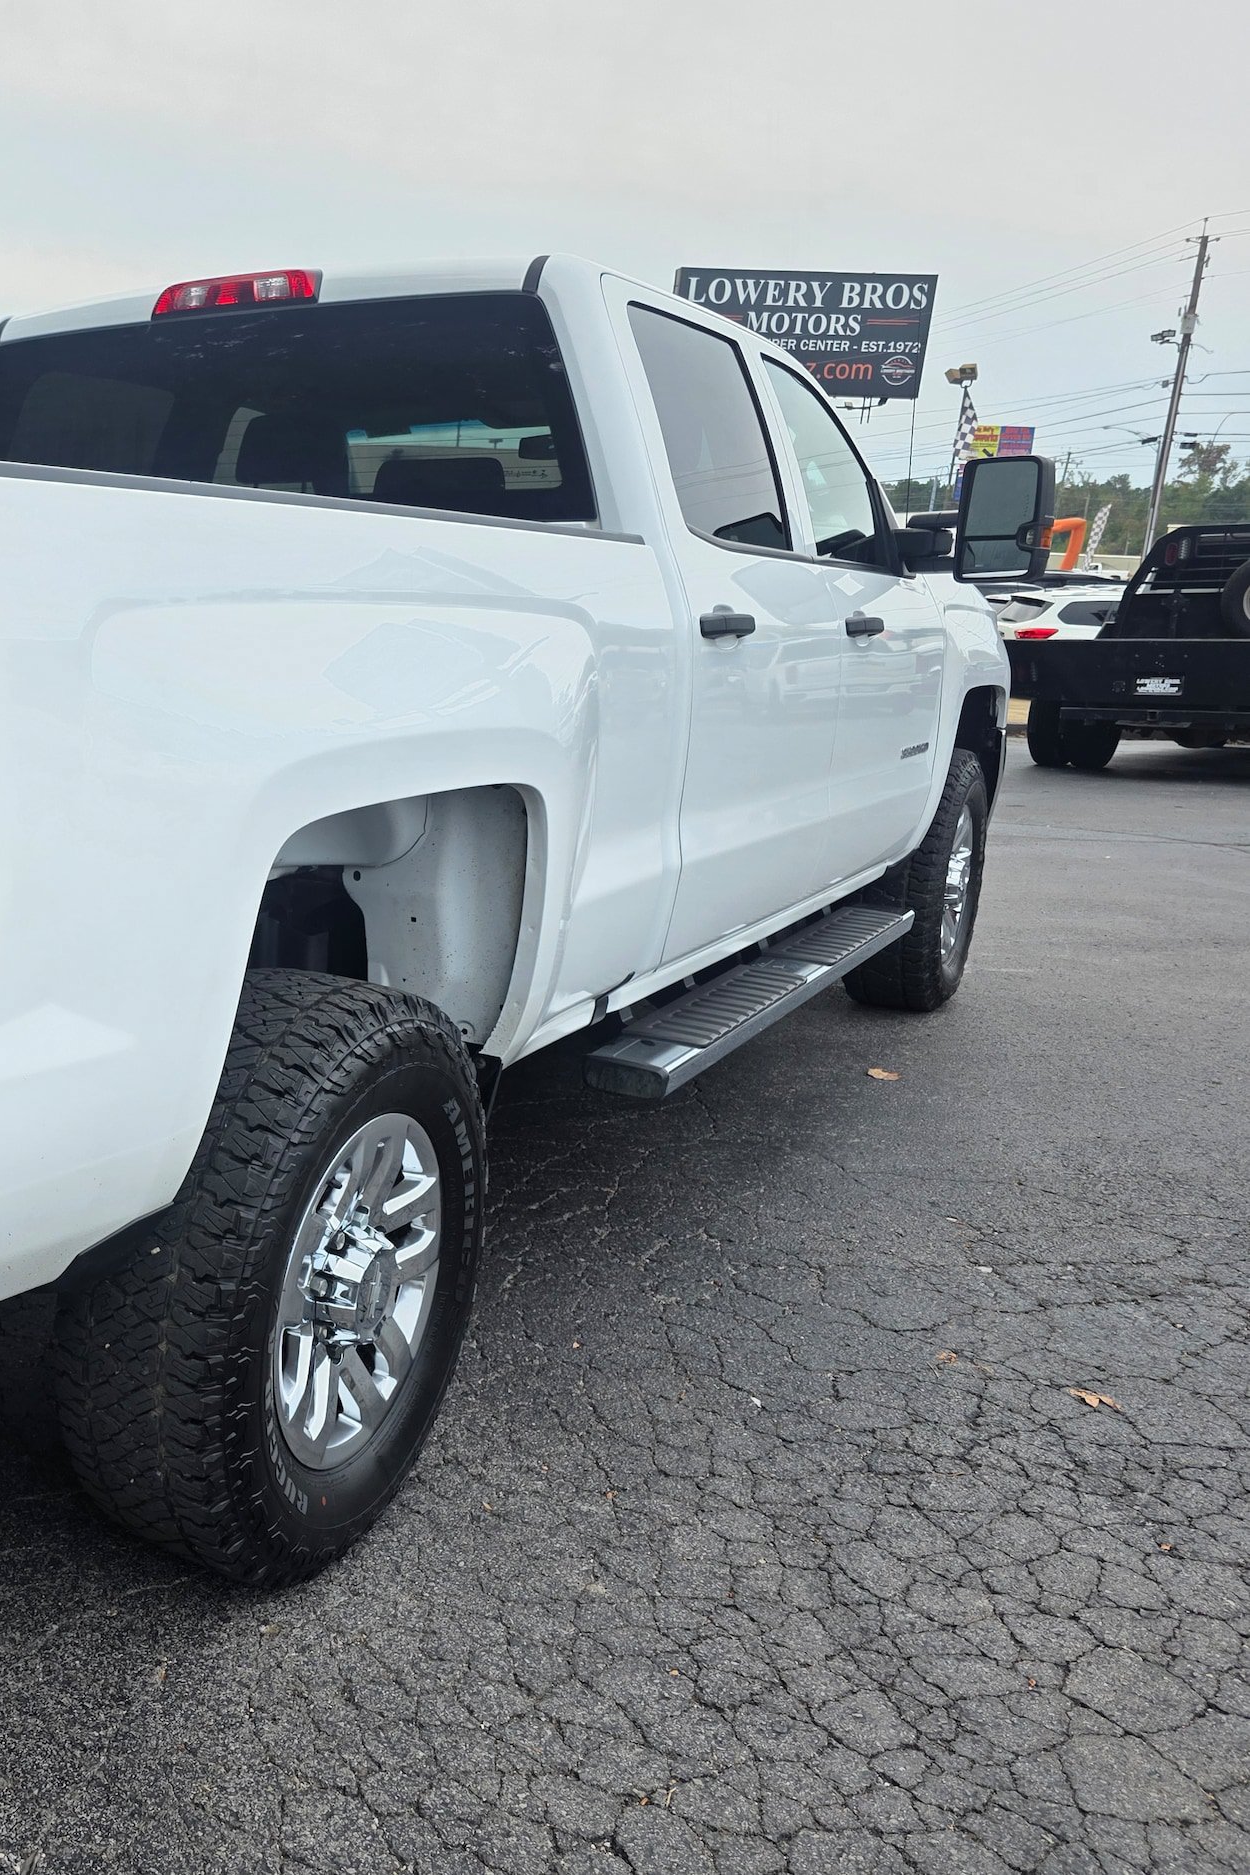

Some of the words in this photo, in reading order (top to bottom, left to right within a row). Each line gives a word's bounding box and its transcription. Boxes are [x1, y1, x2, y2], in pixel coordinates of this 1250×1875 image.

[688, 276, 833, 308] LOWERY
[838, 281, 929, 310] BROS
[747, 311, 861, 336] MOTORS
[800, 339, 850, 352] CENTER
[861, 340, 921, 354] EST.1972
